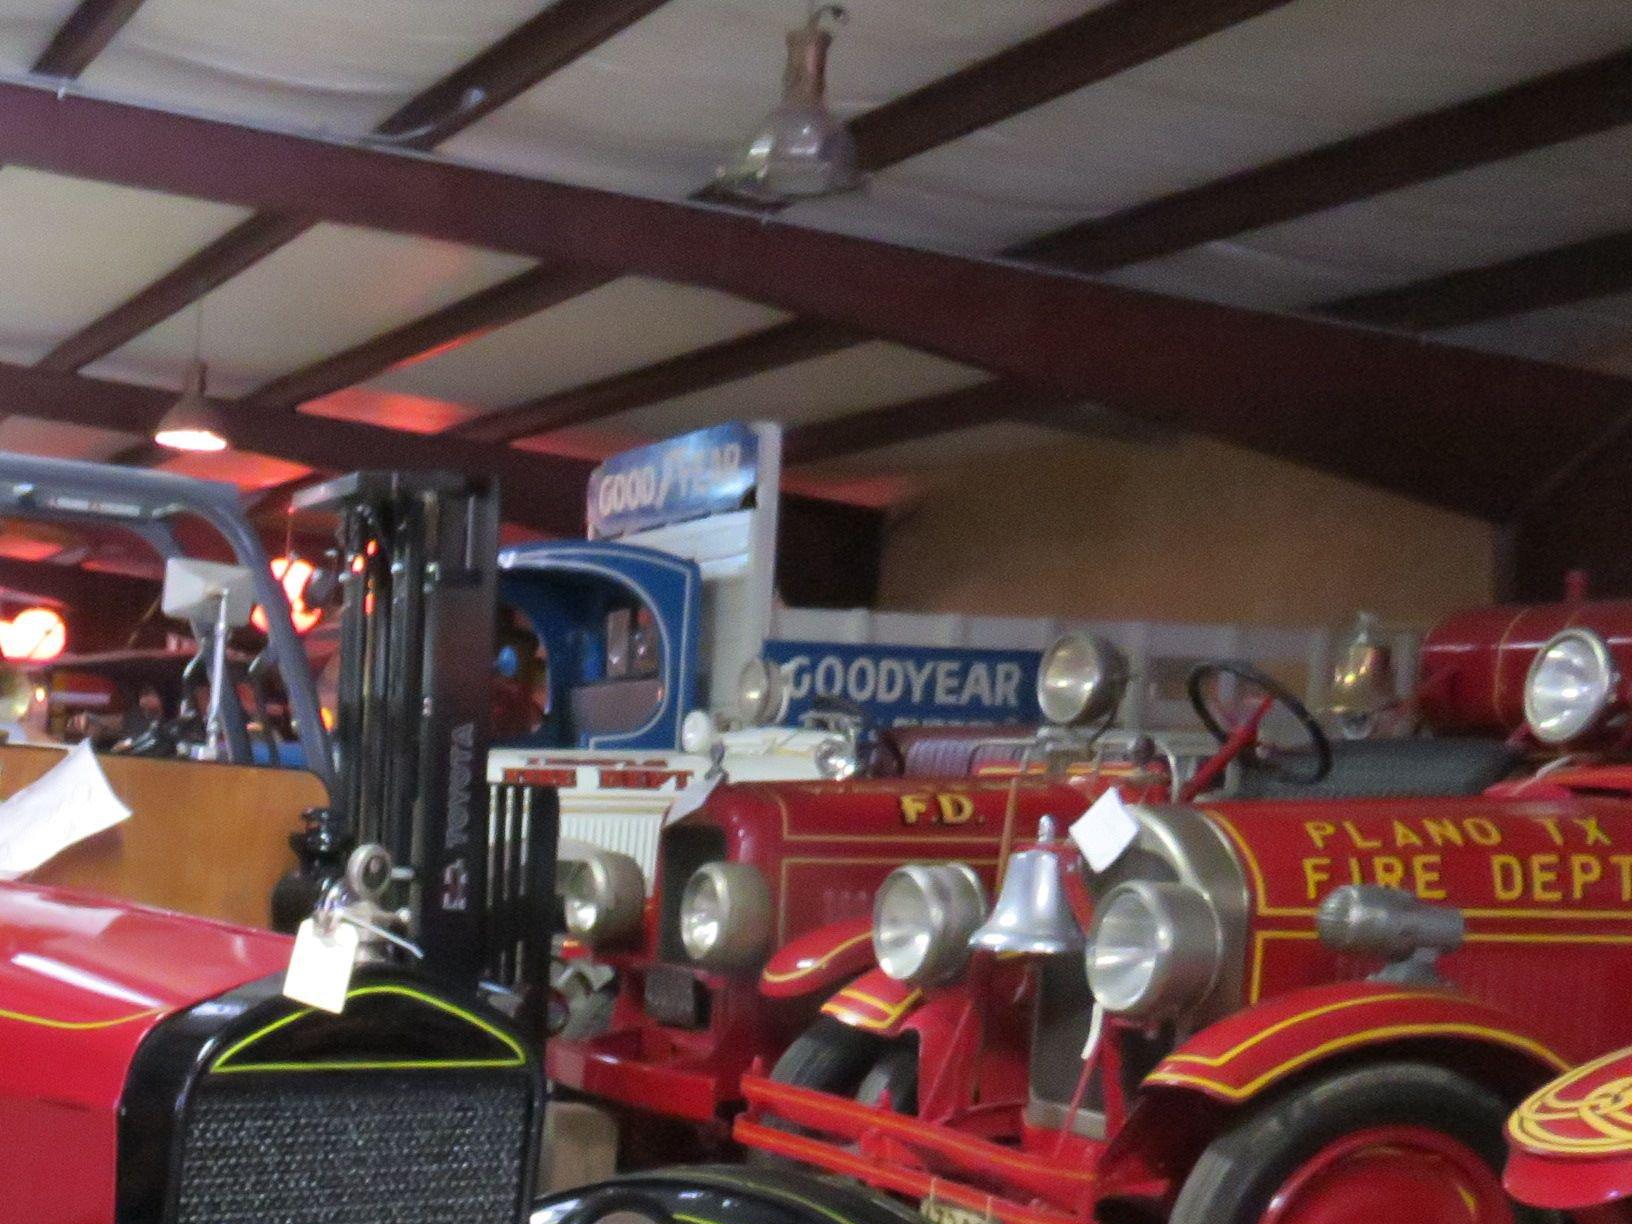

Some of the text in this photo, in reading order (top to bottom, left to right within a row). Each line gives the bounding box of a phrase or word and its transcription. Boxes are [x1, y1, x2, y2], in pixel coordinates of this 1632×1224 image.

[780, 655, 1022, 706] GOODYEAR
[1304, 816, 1613, 850] PLANO TX
[1302, 853, 1448, 901] FIRE
